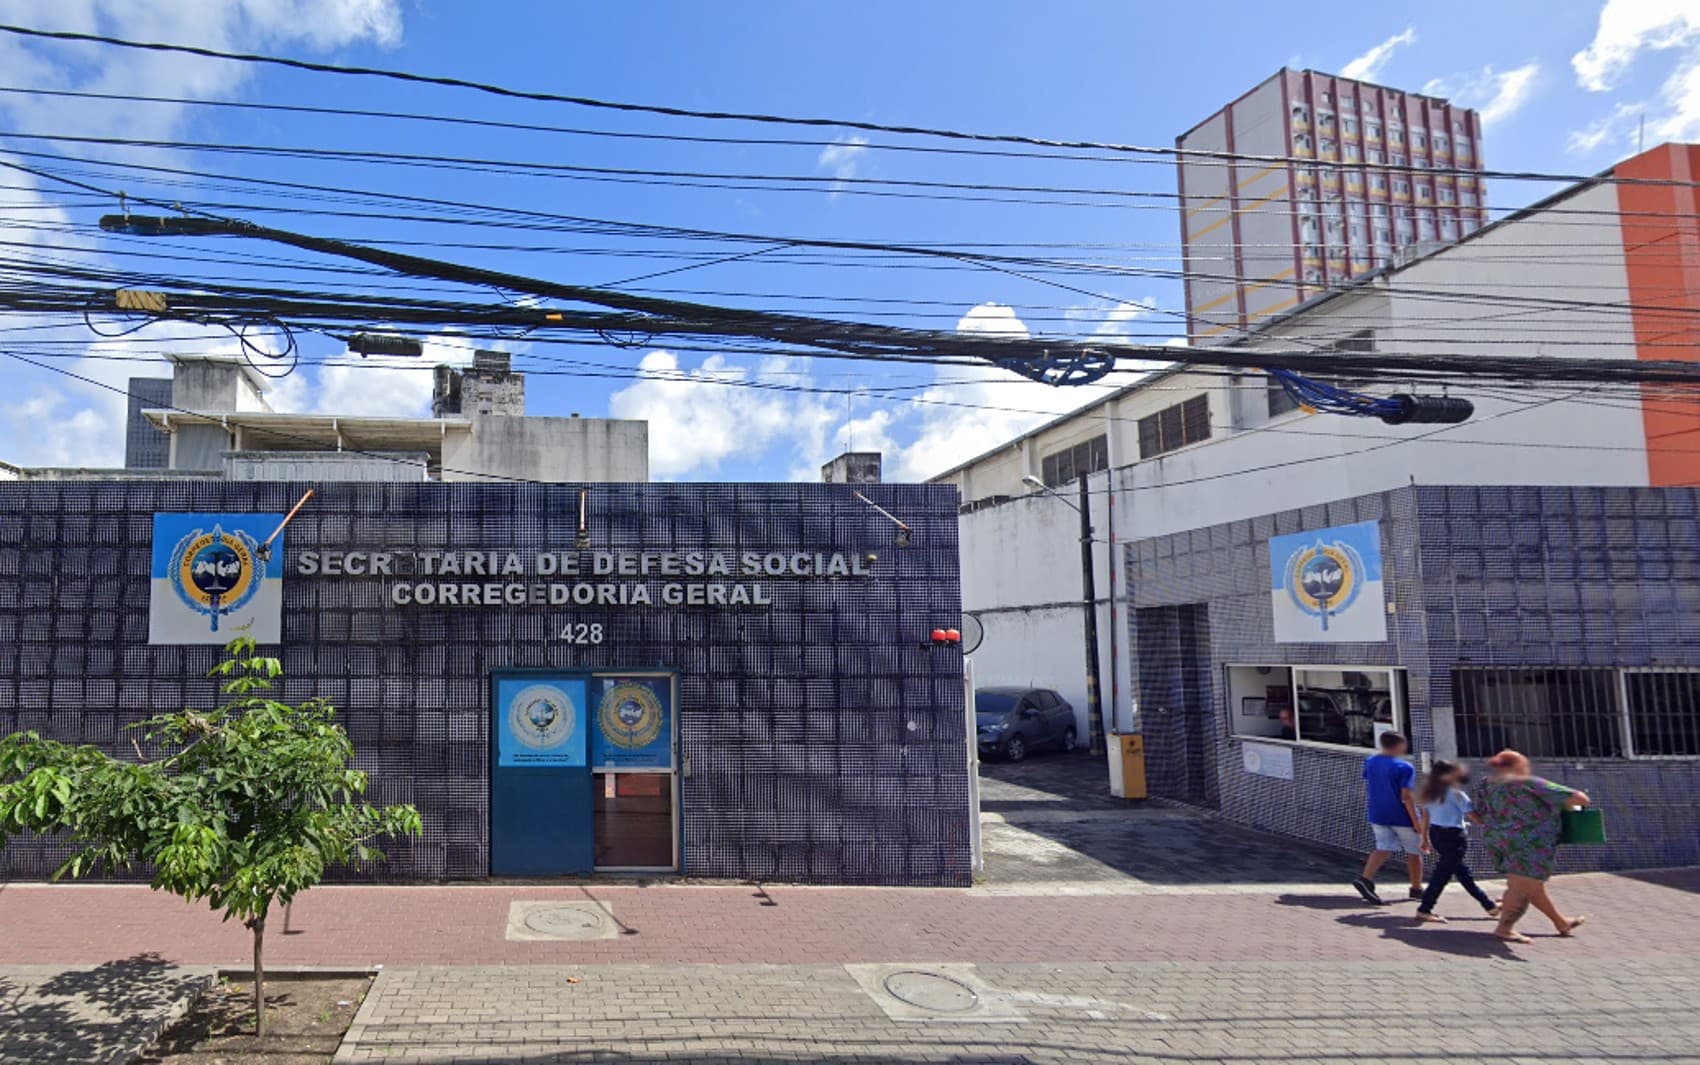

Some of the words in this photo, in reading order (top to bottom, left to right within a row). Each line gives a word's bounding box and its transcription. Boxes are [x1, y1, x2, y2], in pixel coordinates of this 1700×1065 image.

[299, 551, 524, 576] SECRTARIA
[536, 551, 580, 576] DE
[593, 552, 730, 576] DEFESA
[741, 552, 870, 576] SOCIAL
[392, 583, 652, 605] CORREGEDORIA
[662, 583, 772, 605] GERAL
[560, 623, 604, 644] 428
